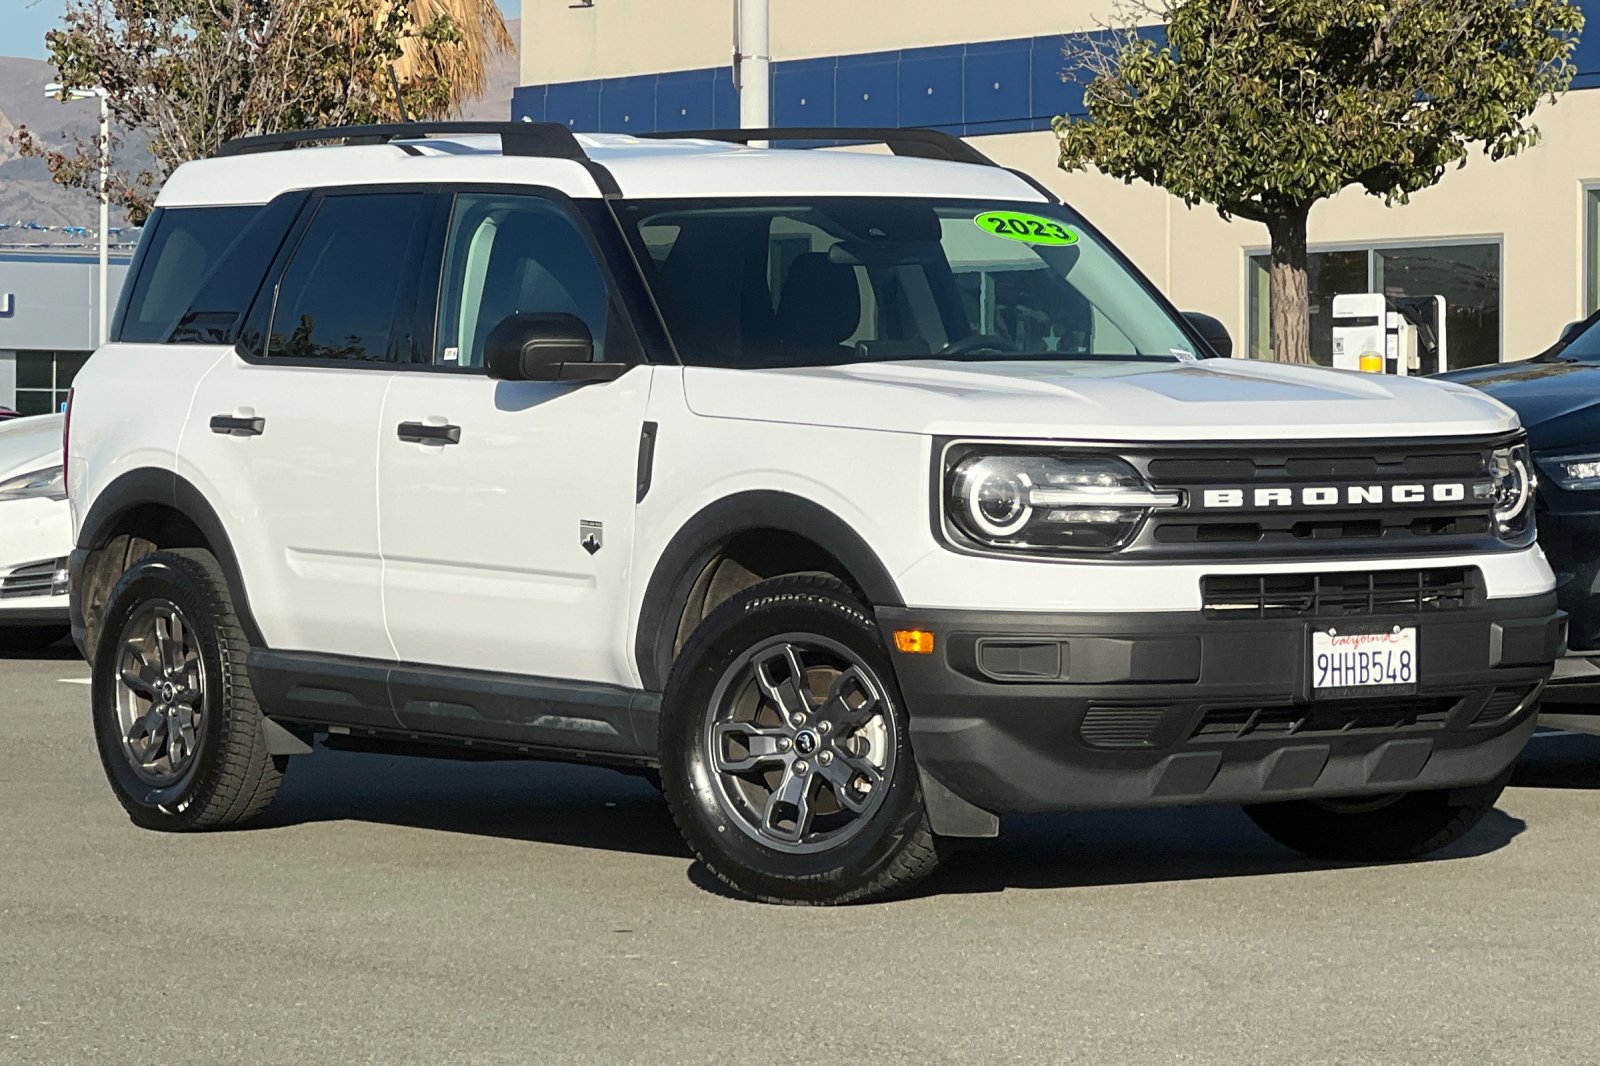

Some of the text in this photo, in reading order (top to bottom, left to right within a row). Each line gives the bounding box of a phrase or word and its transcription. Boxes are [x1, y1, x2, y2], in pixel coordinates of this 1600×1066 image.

[987, 217, 1071, 240] 2023
[1203, 483, 1465, 507] BRONCO
[1317, 650, 1411, 686] 9HHB548
